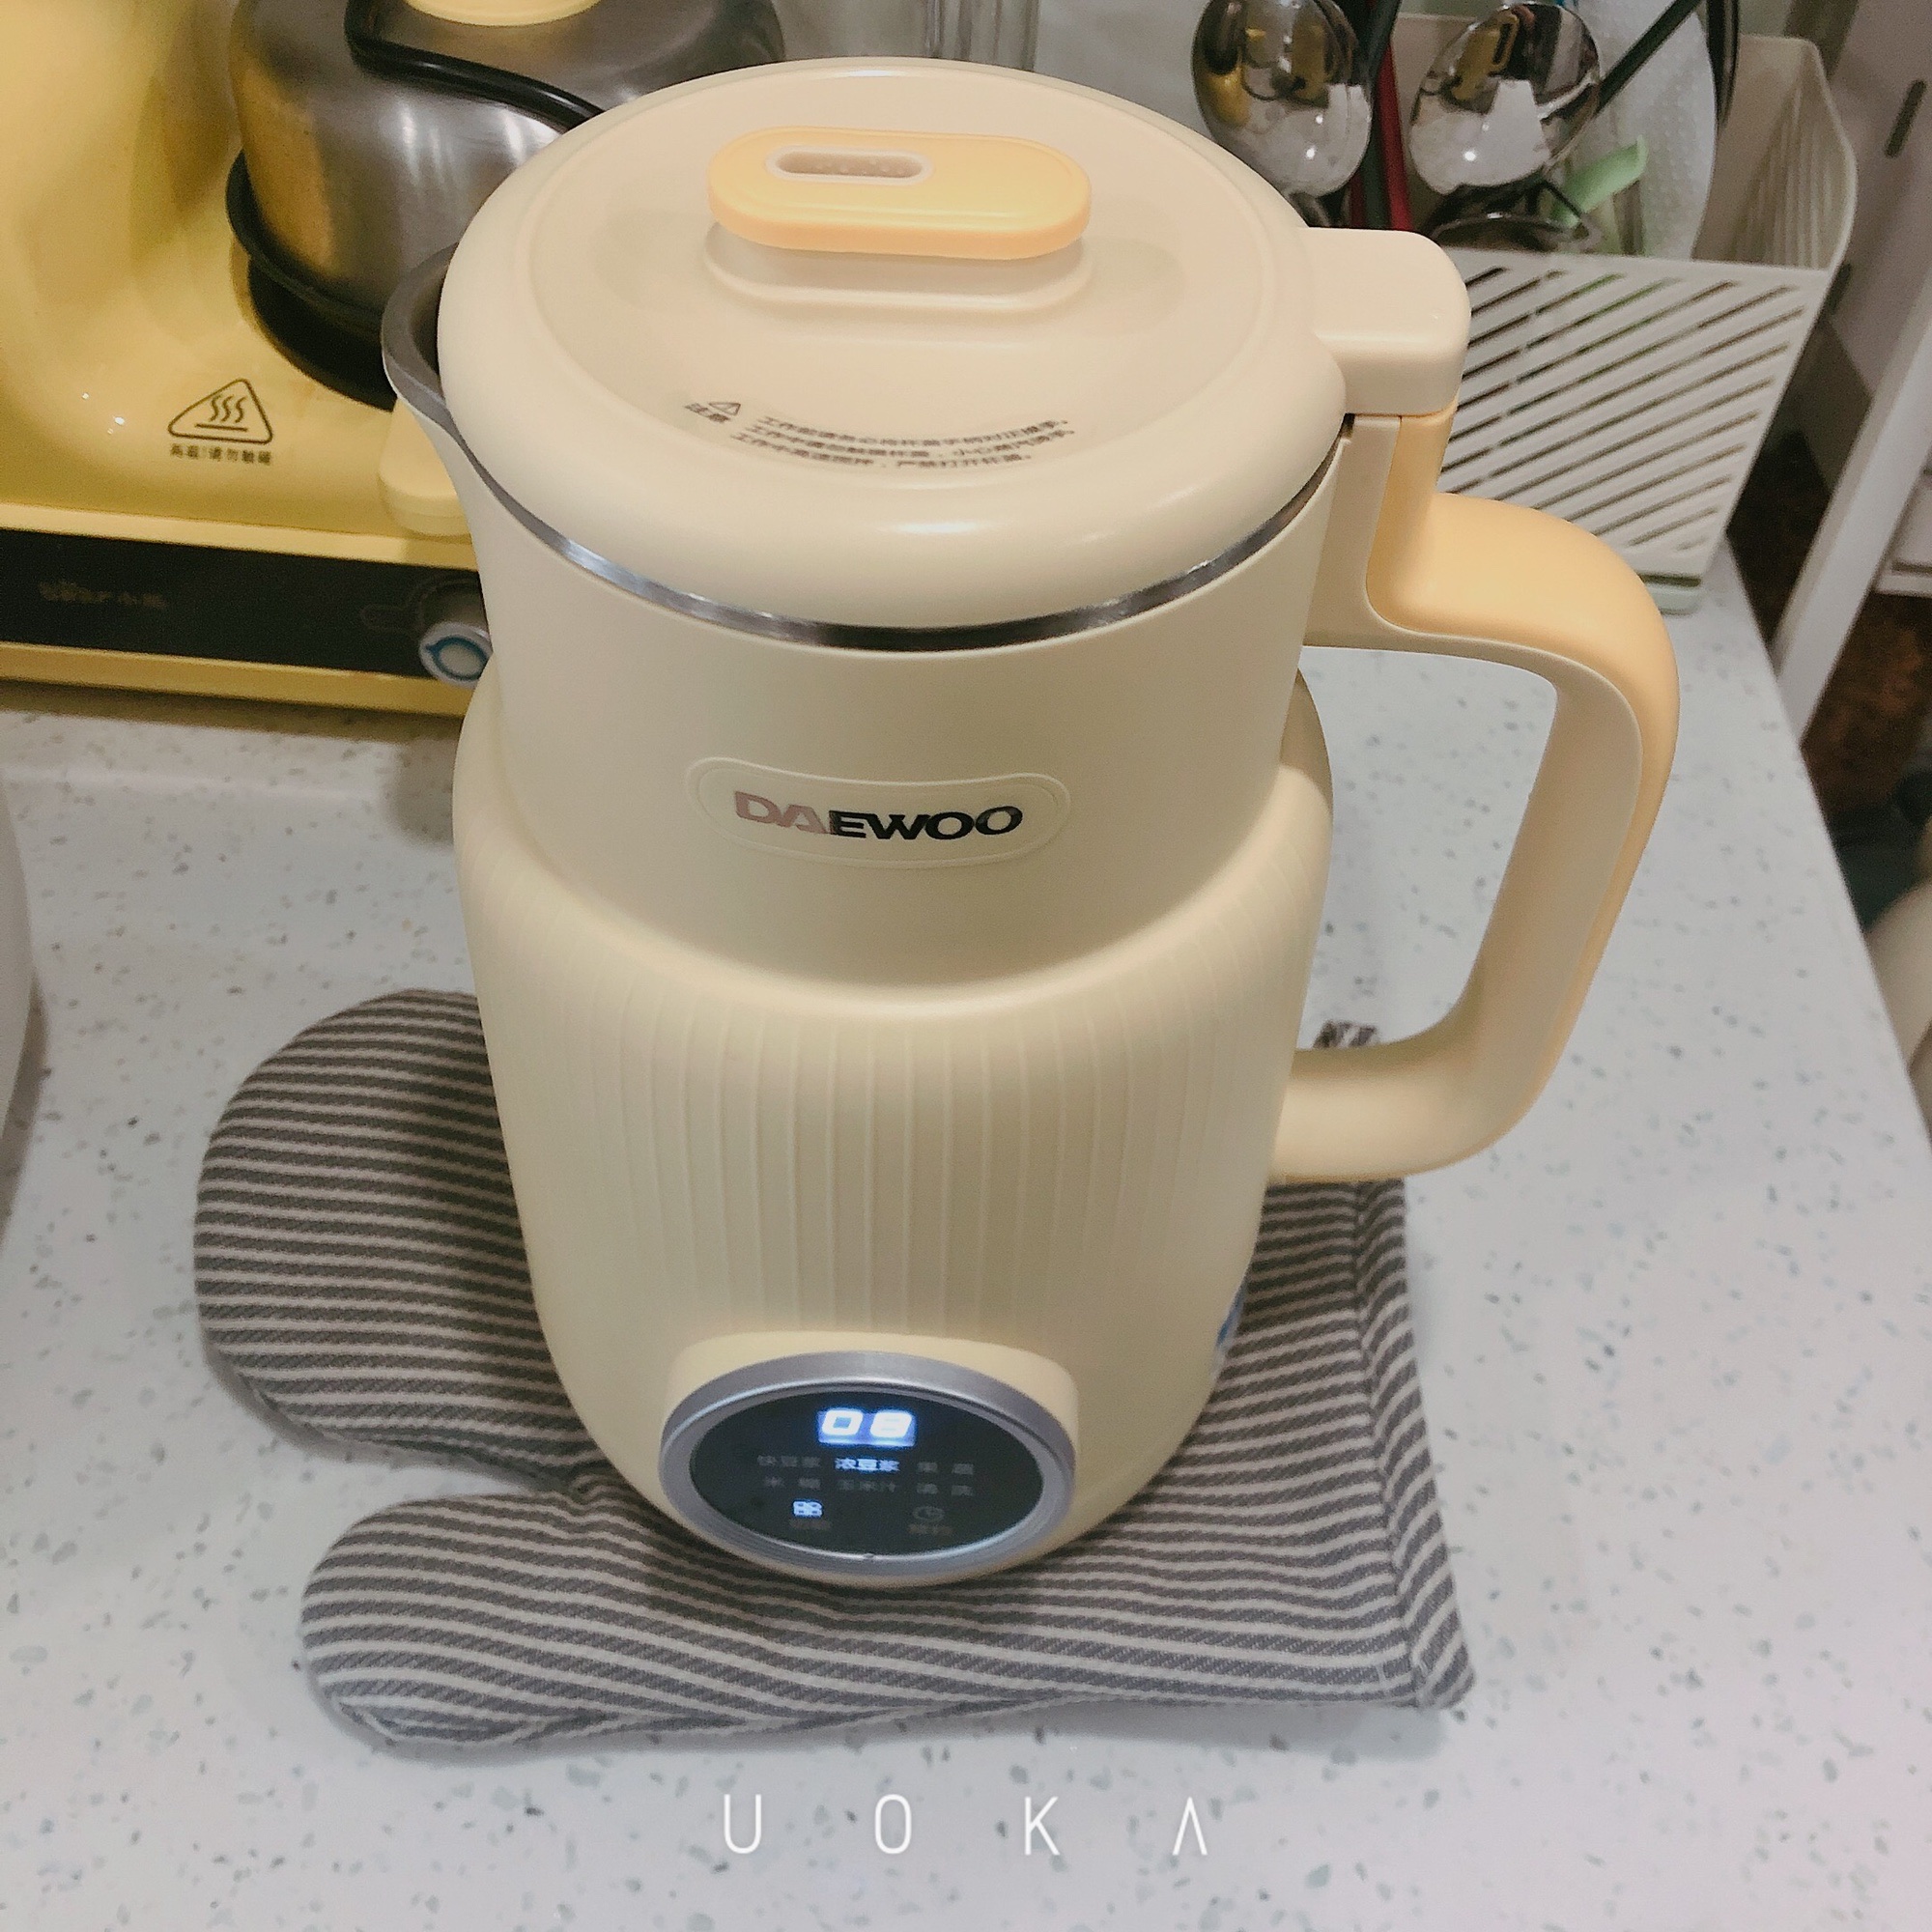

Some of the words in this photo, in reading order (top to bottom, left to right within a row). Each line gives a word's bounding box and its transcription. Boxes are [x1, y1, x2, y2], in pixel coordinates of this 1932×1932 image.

[734, 791, 1024, 839] DAEWOO
[835, 1457, 900, 1473] 浓豆浆
